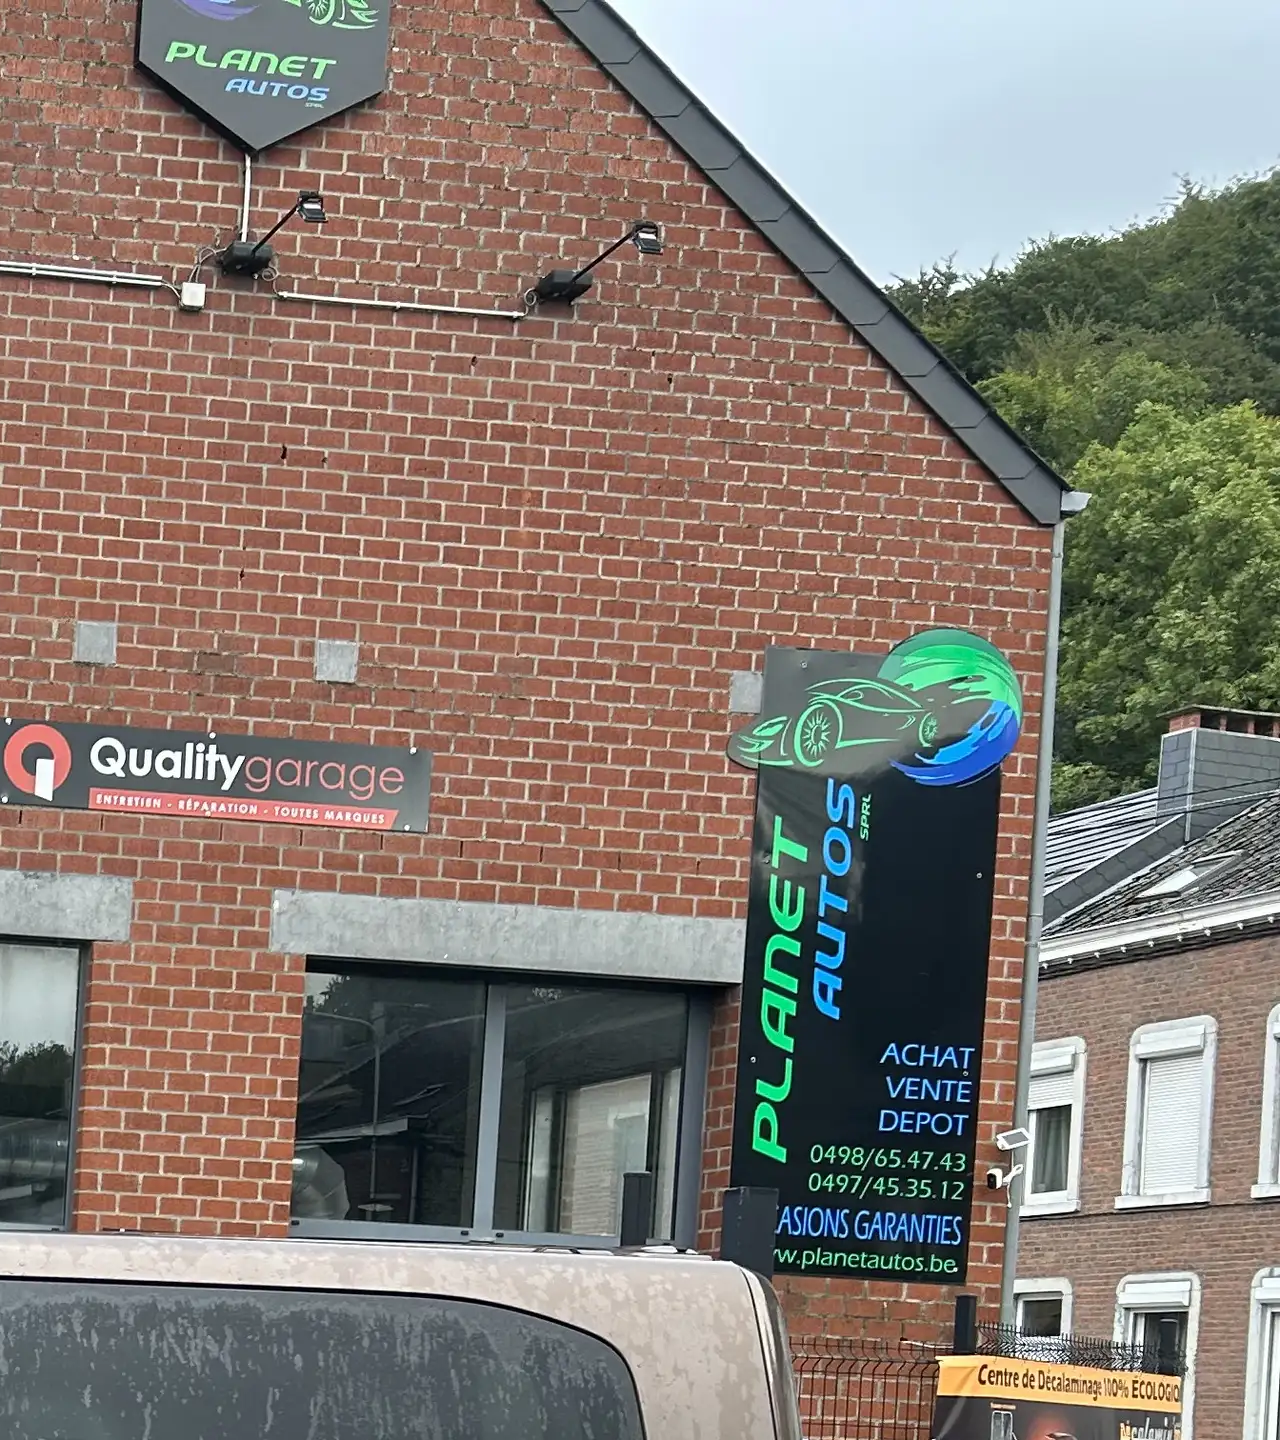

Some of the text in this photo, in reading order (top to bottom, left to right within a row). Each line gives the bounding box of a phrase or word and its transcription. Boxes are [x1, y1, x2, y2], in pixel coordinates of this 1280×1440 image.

[164, 41, 337, 80] PLANET
[225, 77, 330, 102] AUTOS
[95, 792, 162, 809] ENTRETIEN
[178, 796, 258, 815] RÉPARATION
[274, 805, 319, 820] TOUTES
[324, 809, 386, 825] MARQUES
[859, 793, 872, 842] SPRL
[813, 777, 857, 1020] AUTOS
[752, 815, 808, 1164] PLANET
[880, 1042, 975, 1070] ACHAT
[886, 1076, 973, 1103] VENTE
[878, 1109, 970, 1136] DEPOT
[810, 1144, 967, 1173] 0498/65.47.43
[808, 1172, 965, 1201] 0497/45.35.12
[775, 1205, 851, 1239] ASIONS
[854, 1210, 963, 1246] GARANTIES
[977, 1363, 1019, 1388] Centre
[1022, 1369, 1035, 1389] de
[1039, 1368, 1102, 1401] Décalaminage
[1103, 1377, 1130, 1398] 100%
